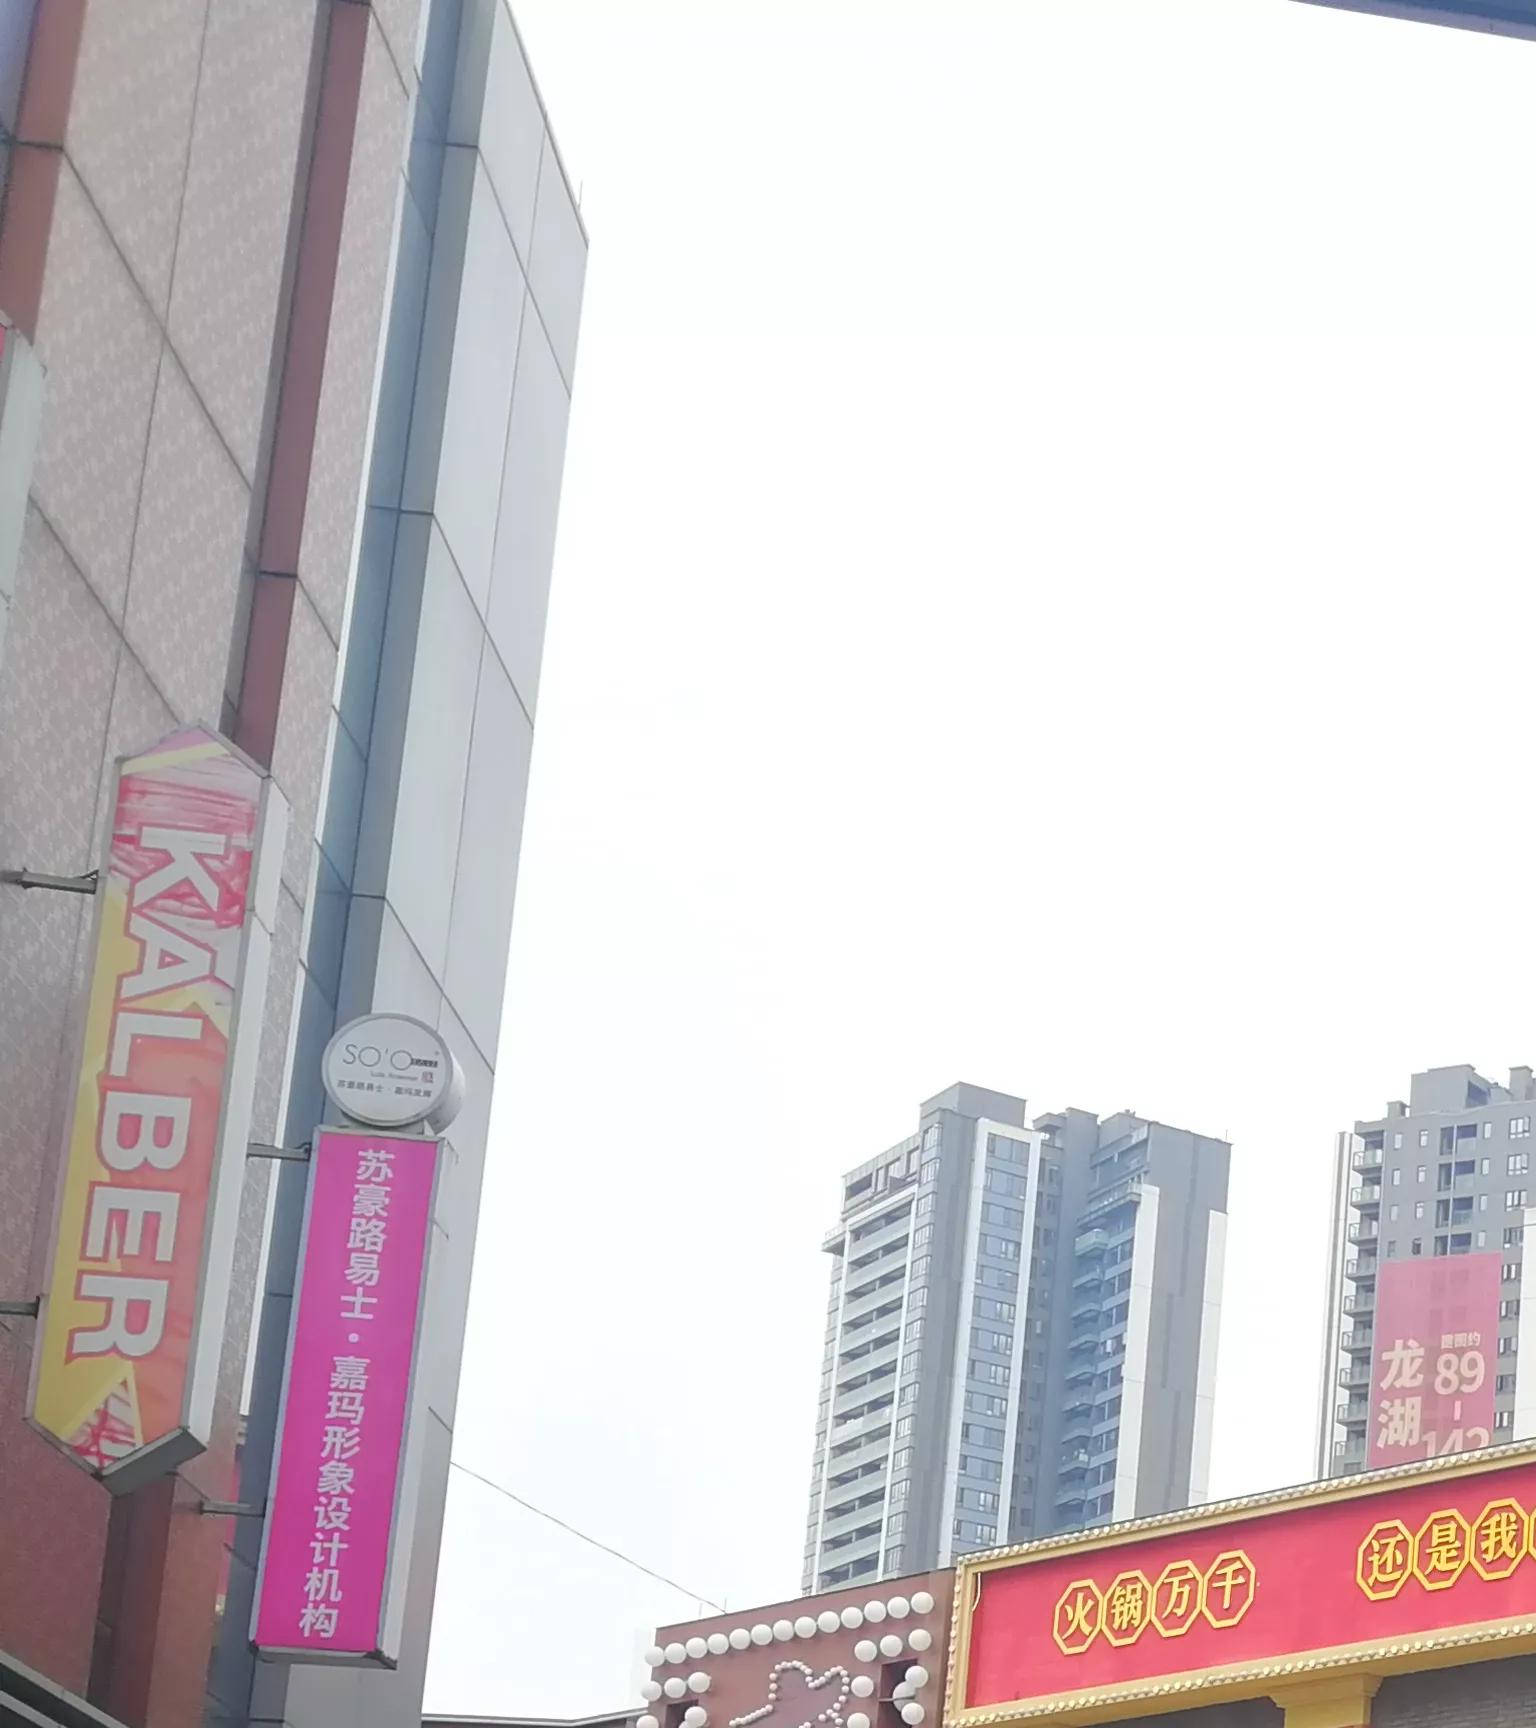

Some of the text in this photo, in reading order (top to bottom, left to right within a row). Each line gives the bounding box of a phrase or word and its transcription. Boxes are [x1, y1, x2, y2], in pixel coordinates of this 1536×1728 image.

[66, 822, 229, 1358] KALBER
[1377, 1338, 1425, 1449] 龙湖
[1434, 1350, 1486, 1395] 89
[1061, 1560, 1247, 1641] 火锅万千
